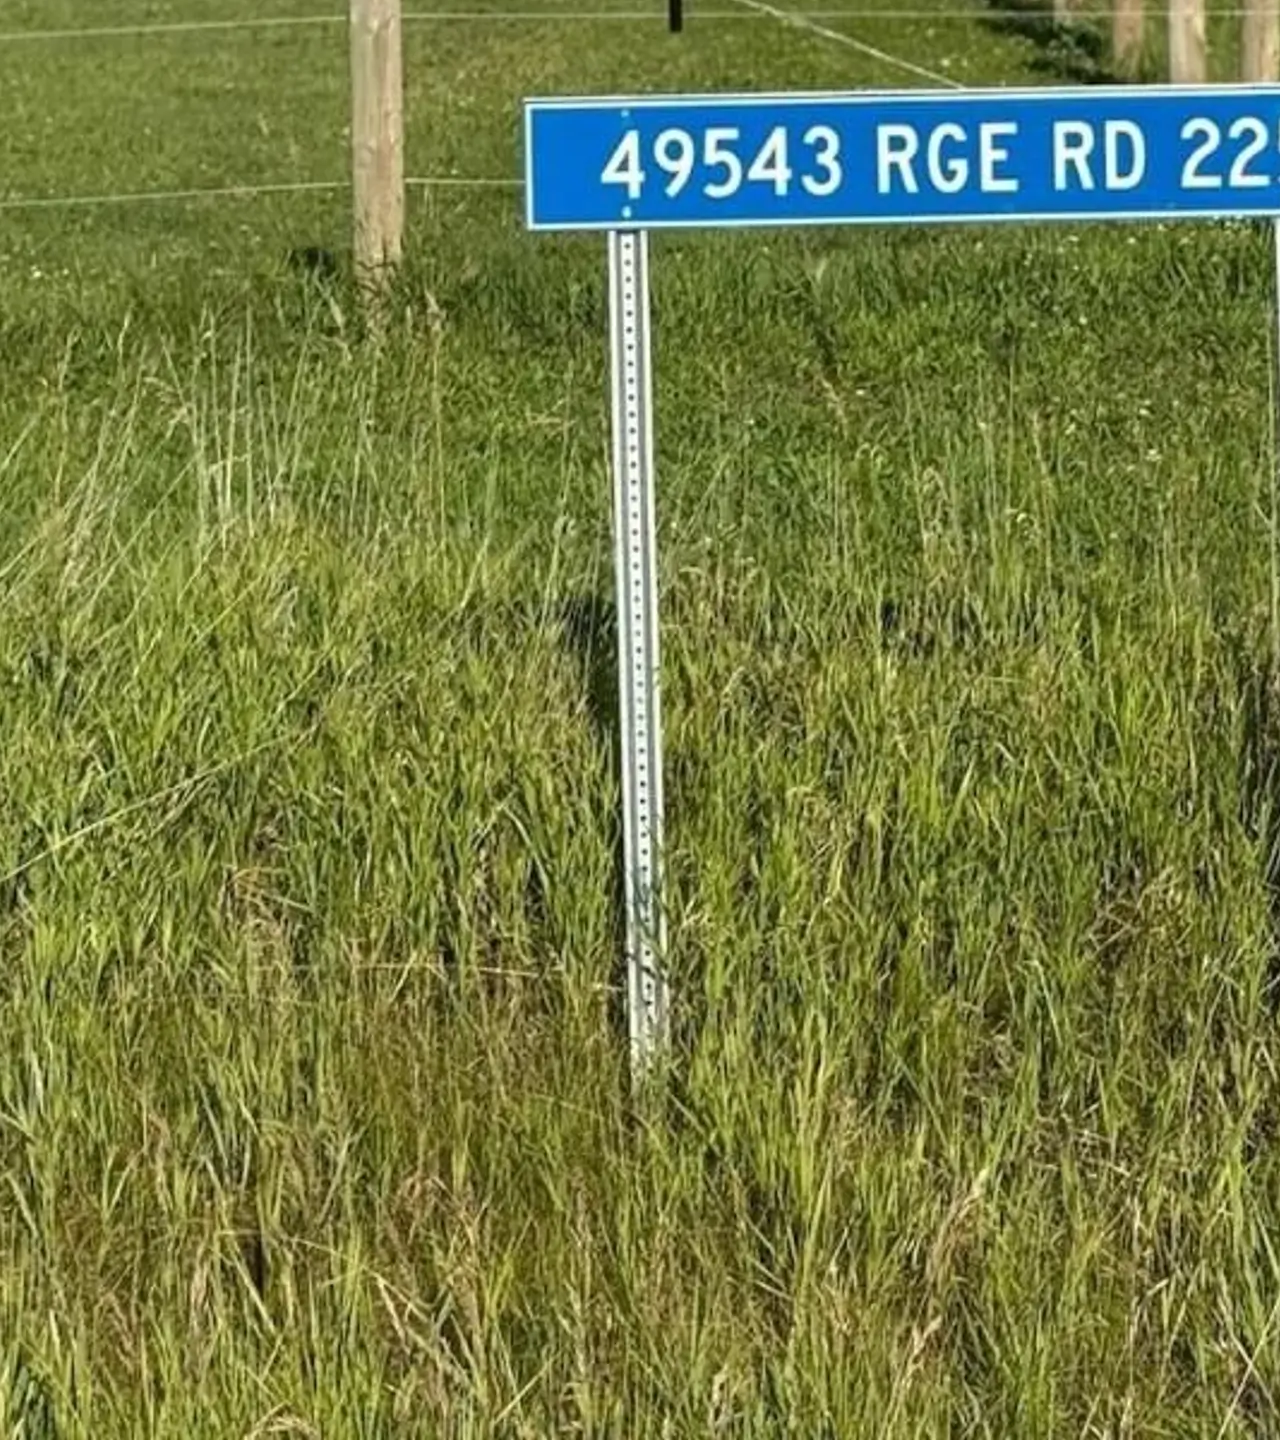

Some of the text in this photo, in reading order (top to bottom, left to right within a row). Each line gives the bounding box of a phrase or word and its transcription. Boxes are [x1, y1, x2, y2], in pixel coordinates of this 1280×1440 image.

[601, 126, 841, 198] 49543
[877, 122, 1018, 193] RGE
[1053, 120, 1145, 190] RD
